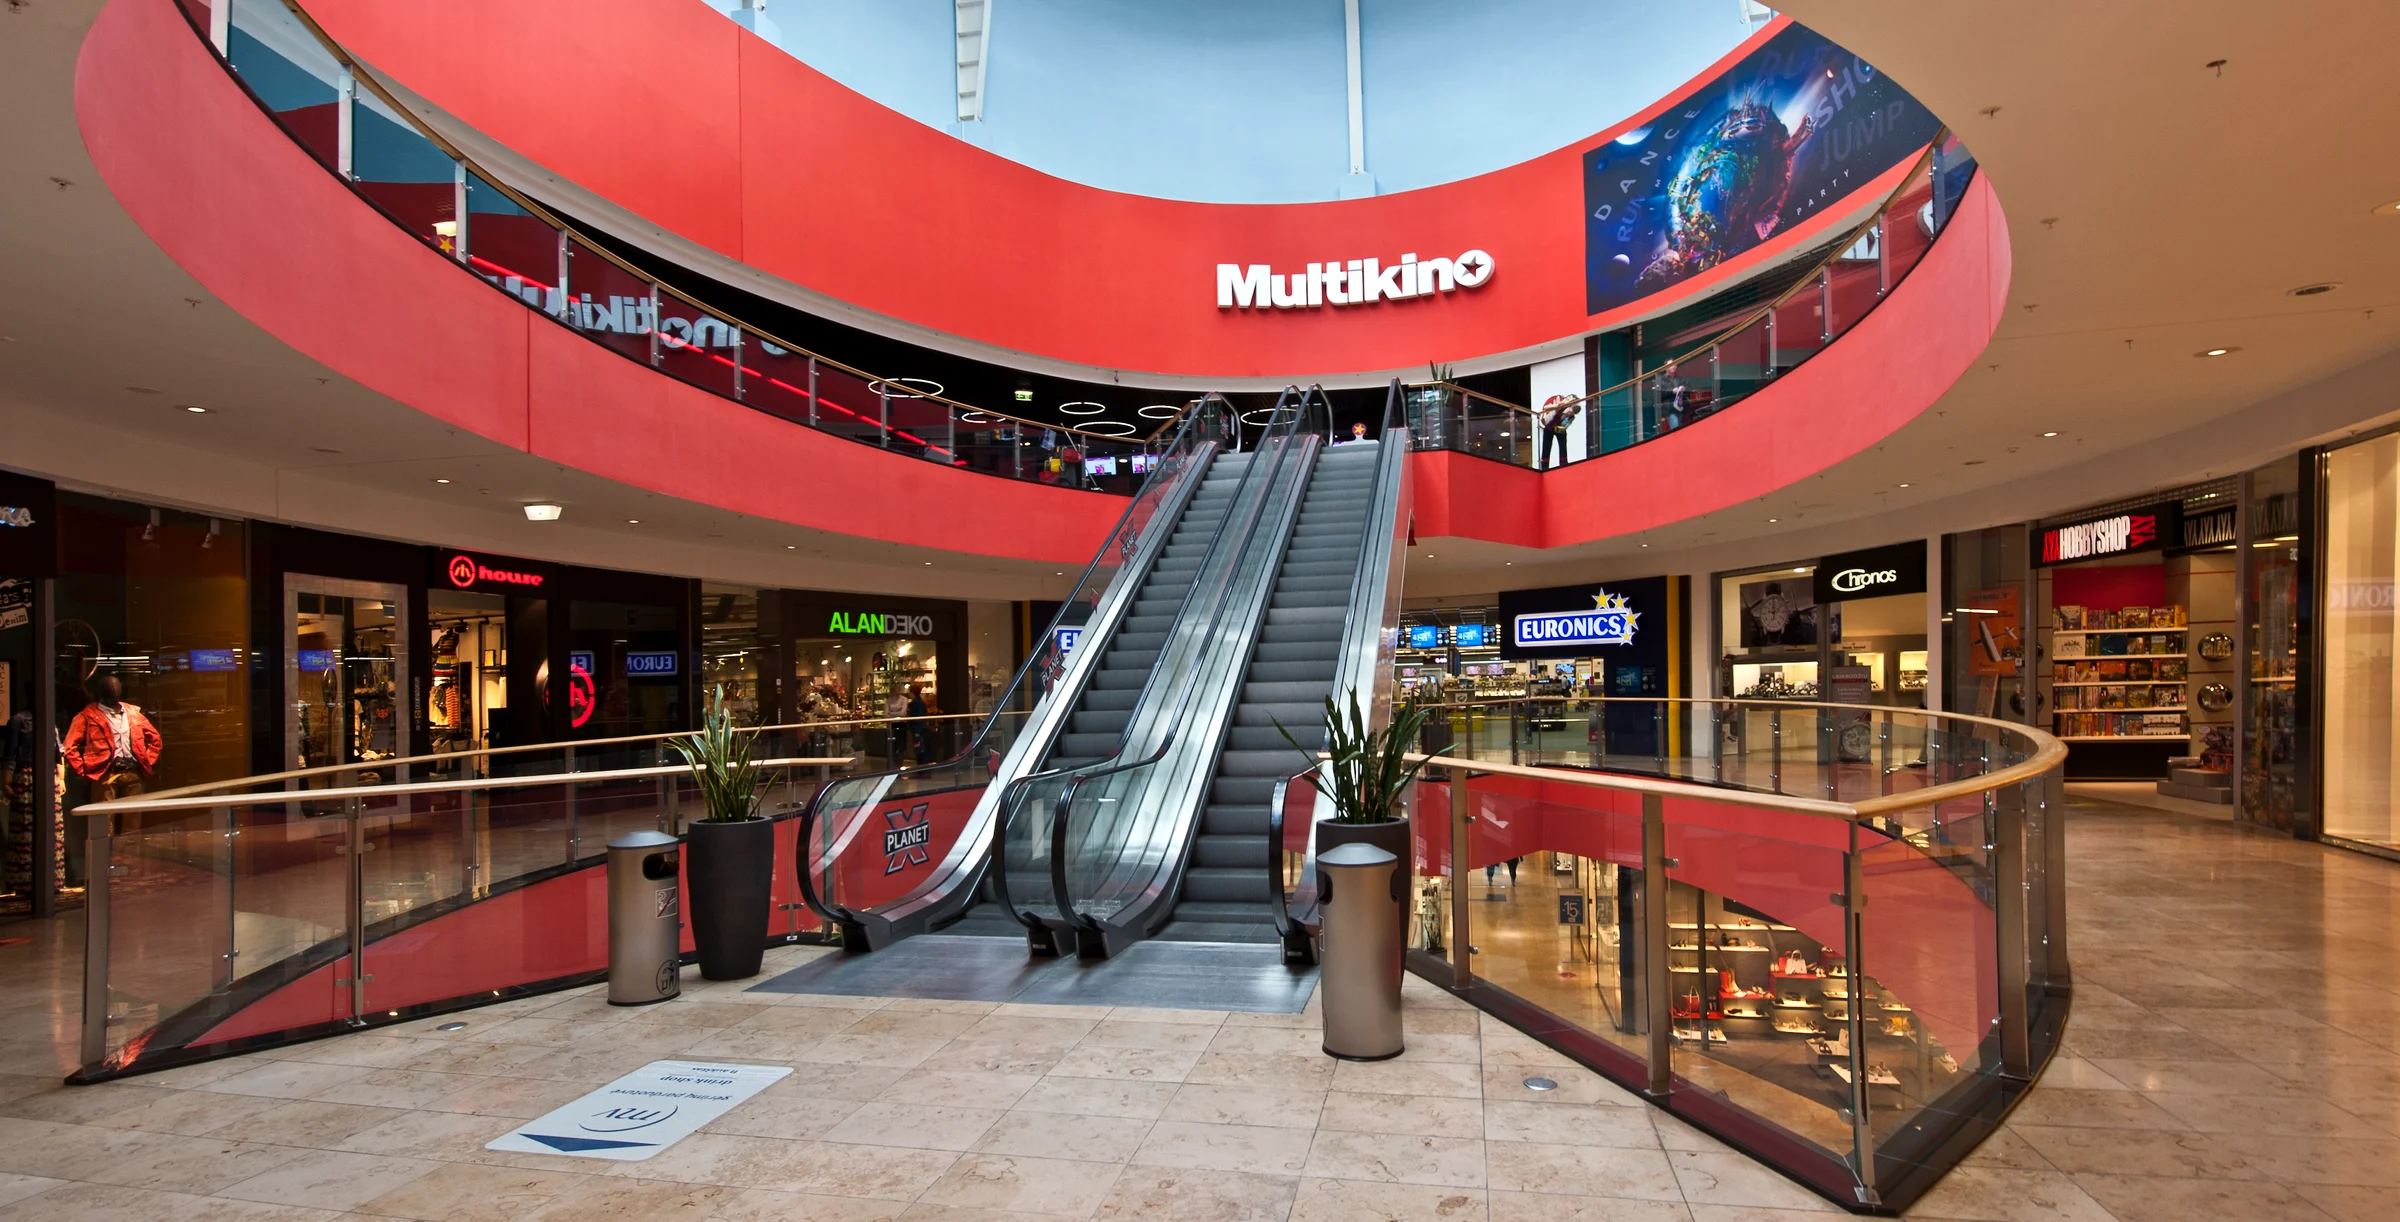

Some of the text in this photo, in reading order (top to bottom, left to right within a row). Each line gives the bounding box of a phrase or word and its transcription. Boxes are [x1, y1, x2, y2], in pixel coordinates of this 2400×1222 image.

[1594, 109, 1700, 221] DANCE
[1796, 168, 1850, 216] PARTY
[1617, 192, 1646, 243] RUN
[1217, 249, 1495, 309] Multikino
[478, 565, 543, 586] house
[1831, 568, 1897, 592] Chronos
[1522, 616, 1621, 639] EURONICS
[887, 824, 928, 852] PLANET
[660, 1074, 733, 1086] drink shop
